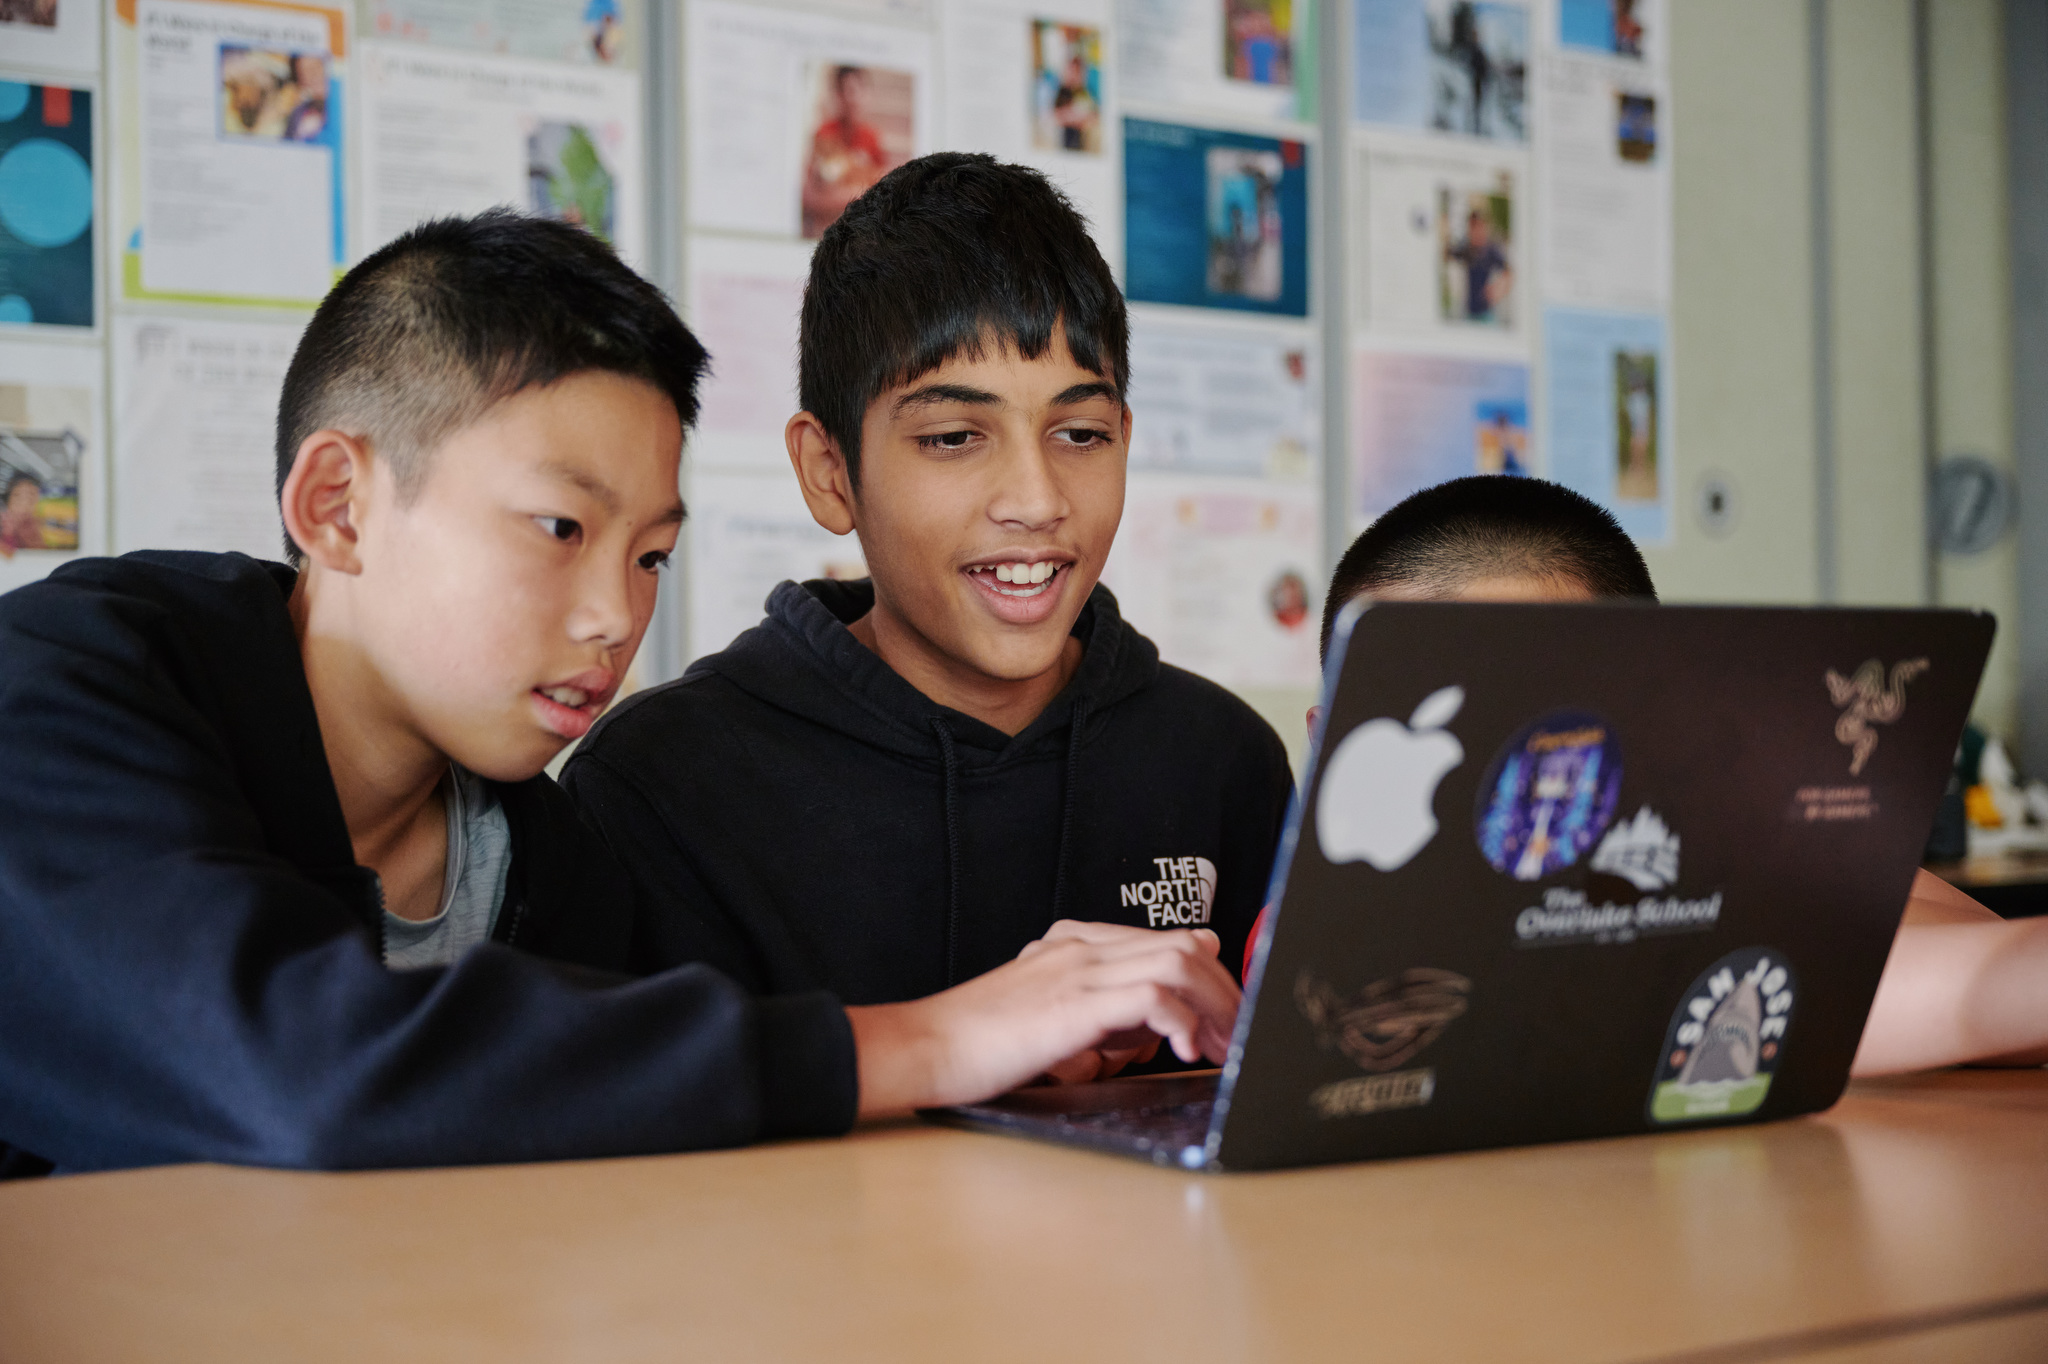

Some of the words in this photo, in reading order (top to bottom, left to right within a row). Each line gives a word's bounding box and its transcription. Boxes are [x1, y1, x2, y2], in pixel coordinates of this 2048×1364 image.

[1153, 856, 1198, 880] THE
[1120, 879, 1201, 907] NORTH
[1147, 901, 1202, 927] FACE
[1635, 892, 1723, 928] School
[1676, 966, 1736, 1047] SAN
[1743, 956, 1794, 1040] JOSE
